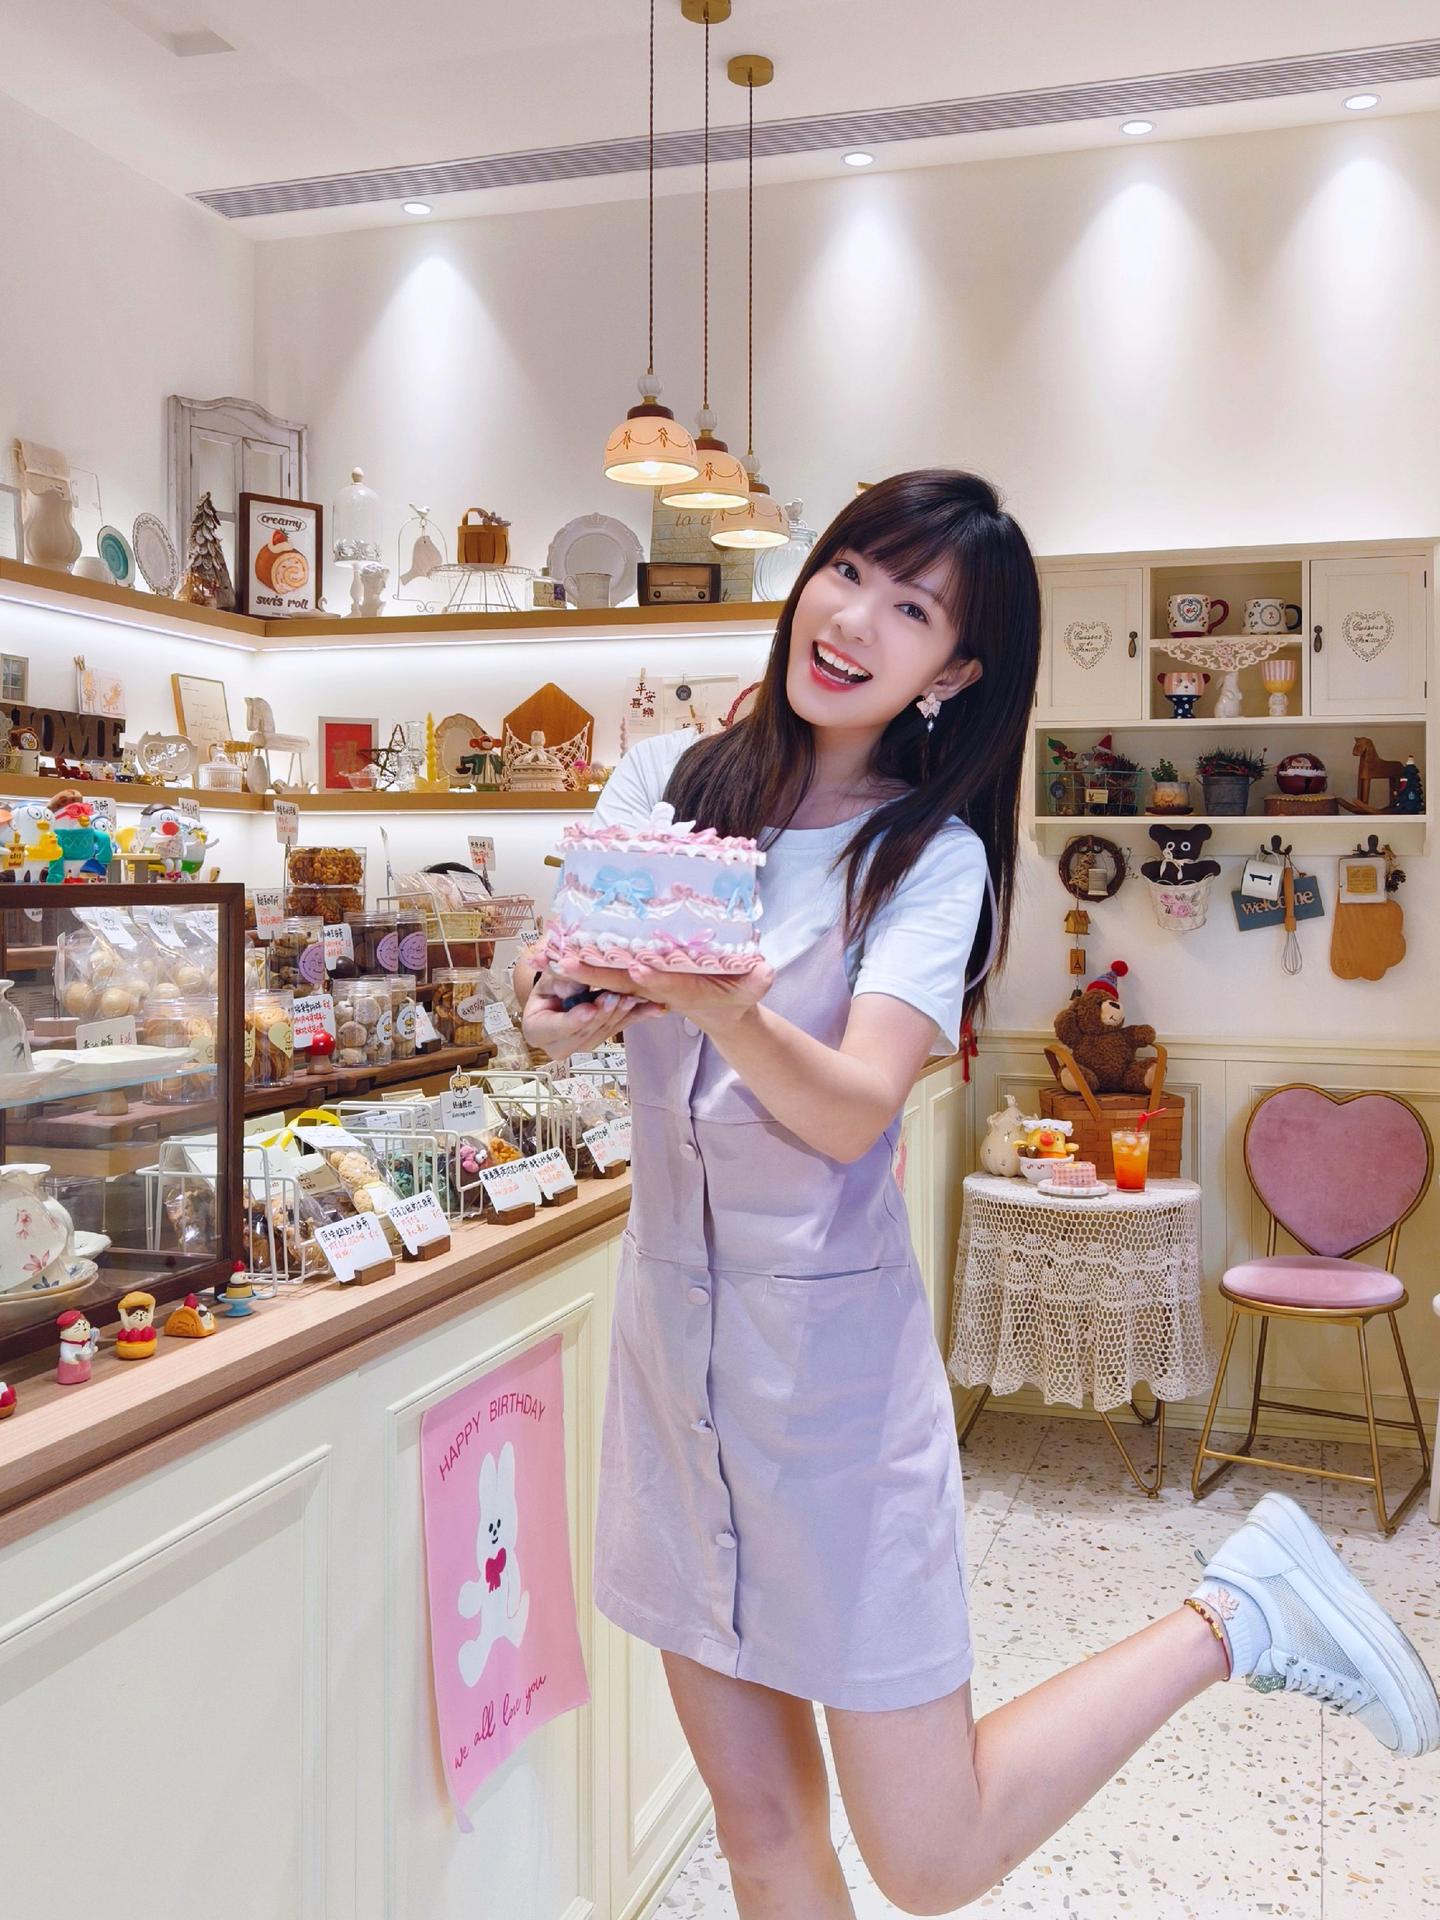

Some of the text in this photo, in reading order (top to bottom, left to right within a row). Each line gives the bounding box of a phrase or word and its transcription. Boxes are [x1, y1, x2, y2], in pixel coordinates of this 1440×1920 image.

[261, 515, 302, 529] creamy
[256, 594, 309, 610] swis roll
[439, 1392, 546, 1481] HAPPY BIRTHDAY
[455, 1675, 547, 1769] we all love you
